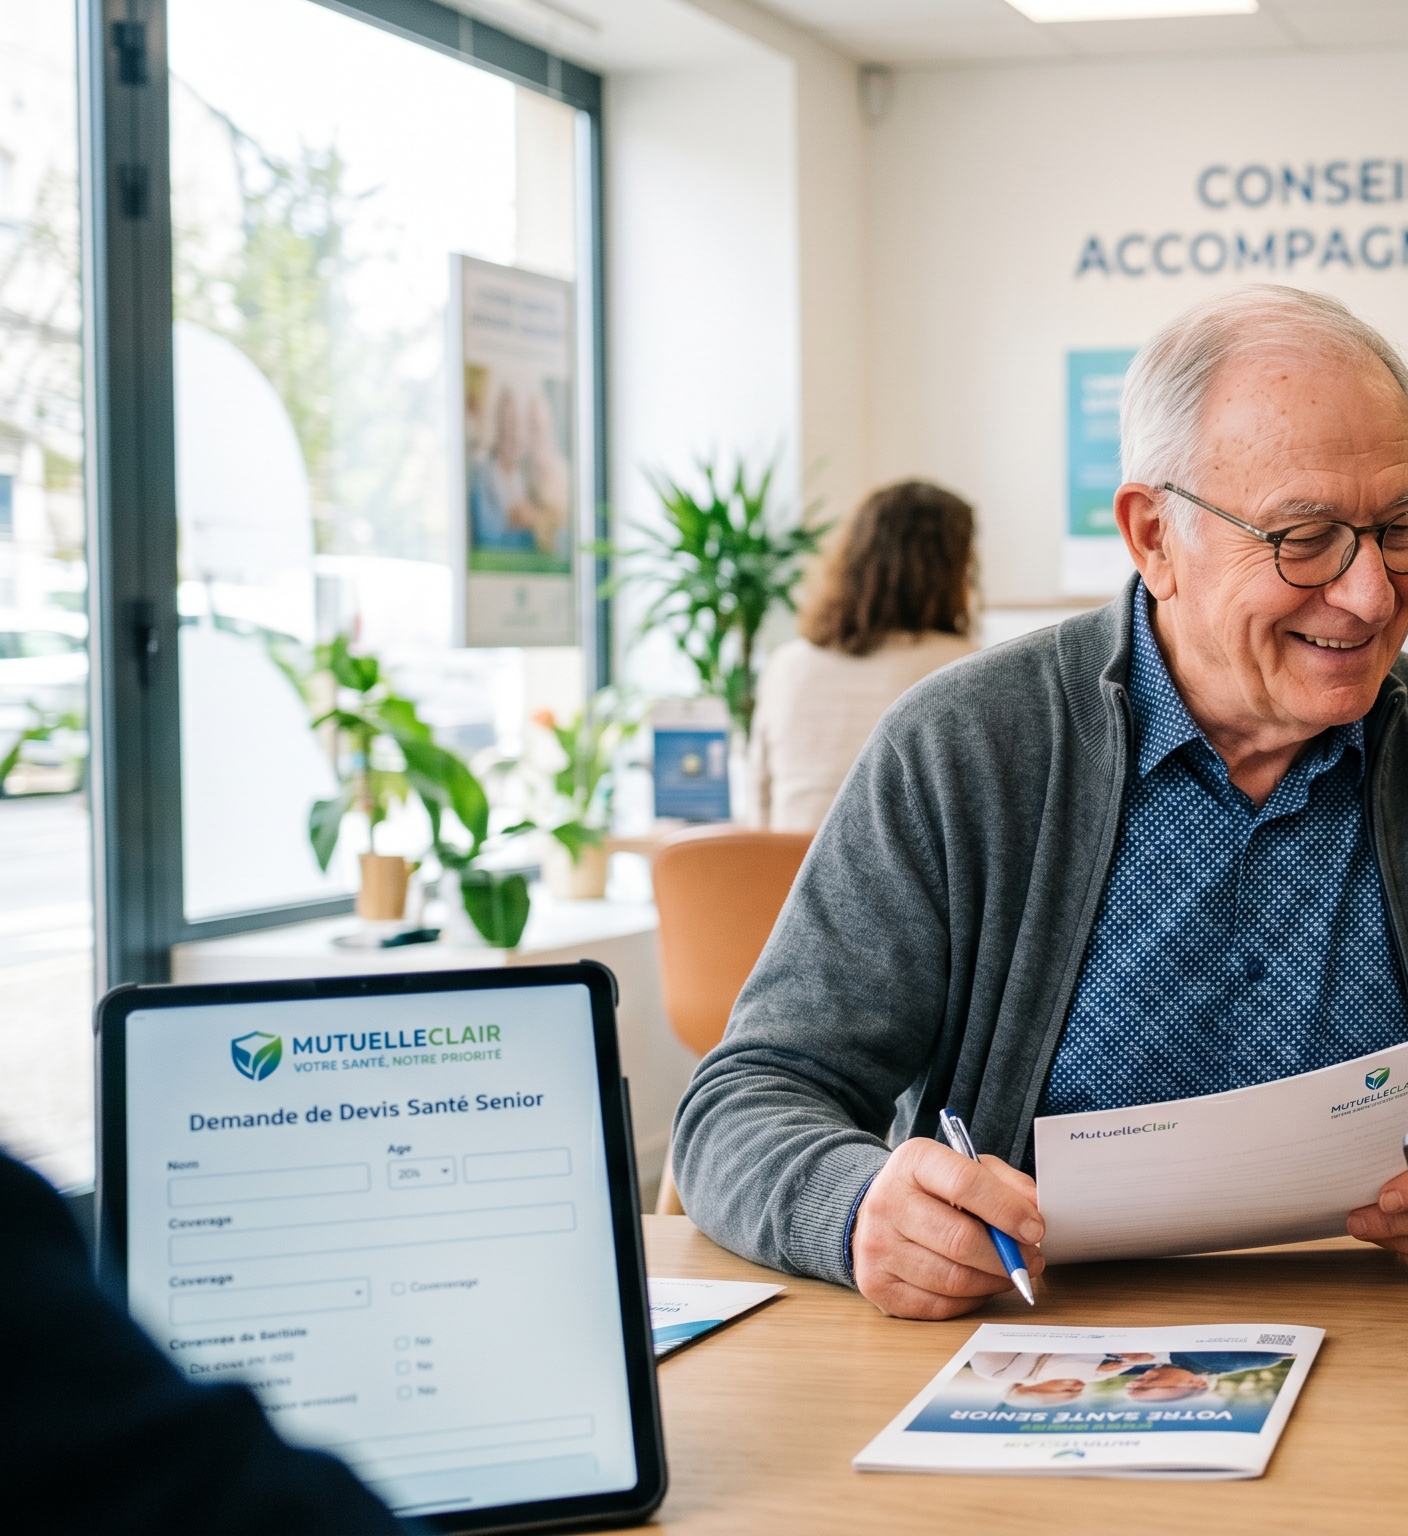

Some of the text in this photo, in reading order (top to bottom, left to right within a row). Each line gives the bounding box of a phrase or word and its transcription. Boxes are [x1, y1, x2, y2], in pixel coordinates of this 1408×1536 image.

[292, 1024, 501, 1055] MUTUELLECLAIR
[294, 1060, 338, 1073] VOTRE
[392, 1054, 437, 1066] NOTRE
[441, 1048, 502, 1064] PRIORITÉ
[189, 1092, 544, 1132] Demande de Devis Santé Senior
[1070, 1121, 1179, 1141] MutuelleClair
[949, 1408, 1234, 1423] VOTRE SANTÉ SENIOR
